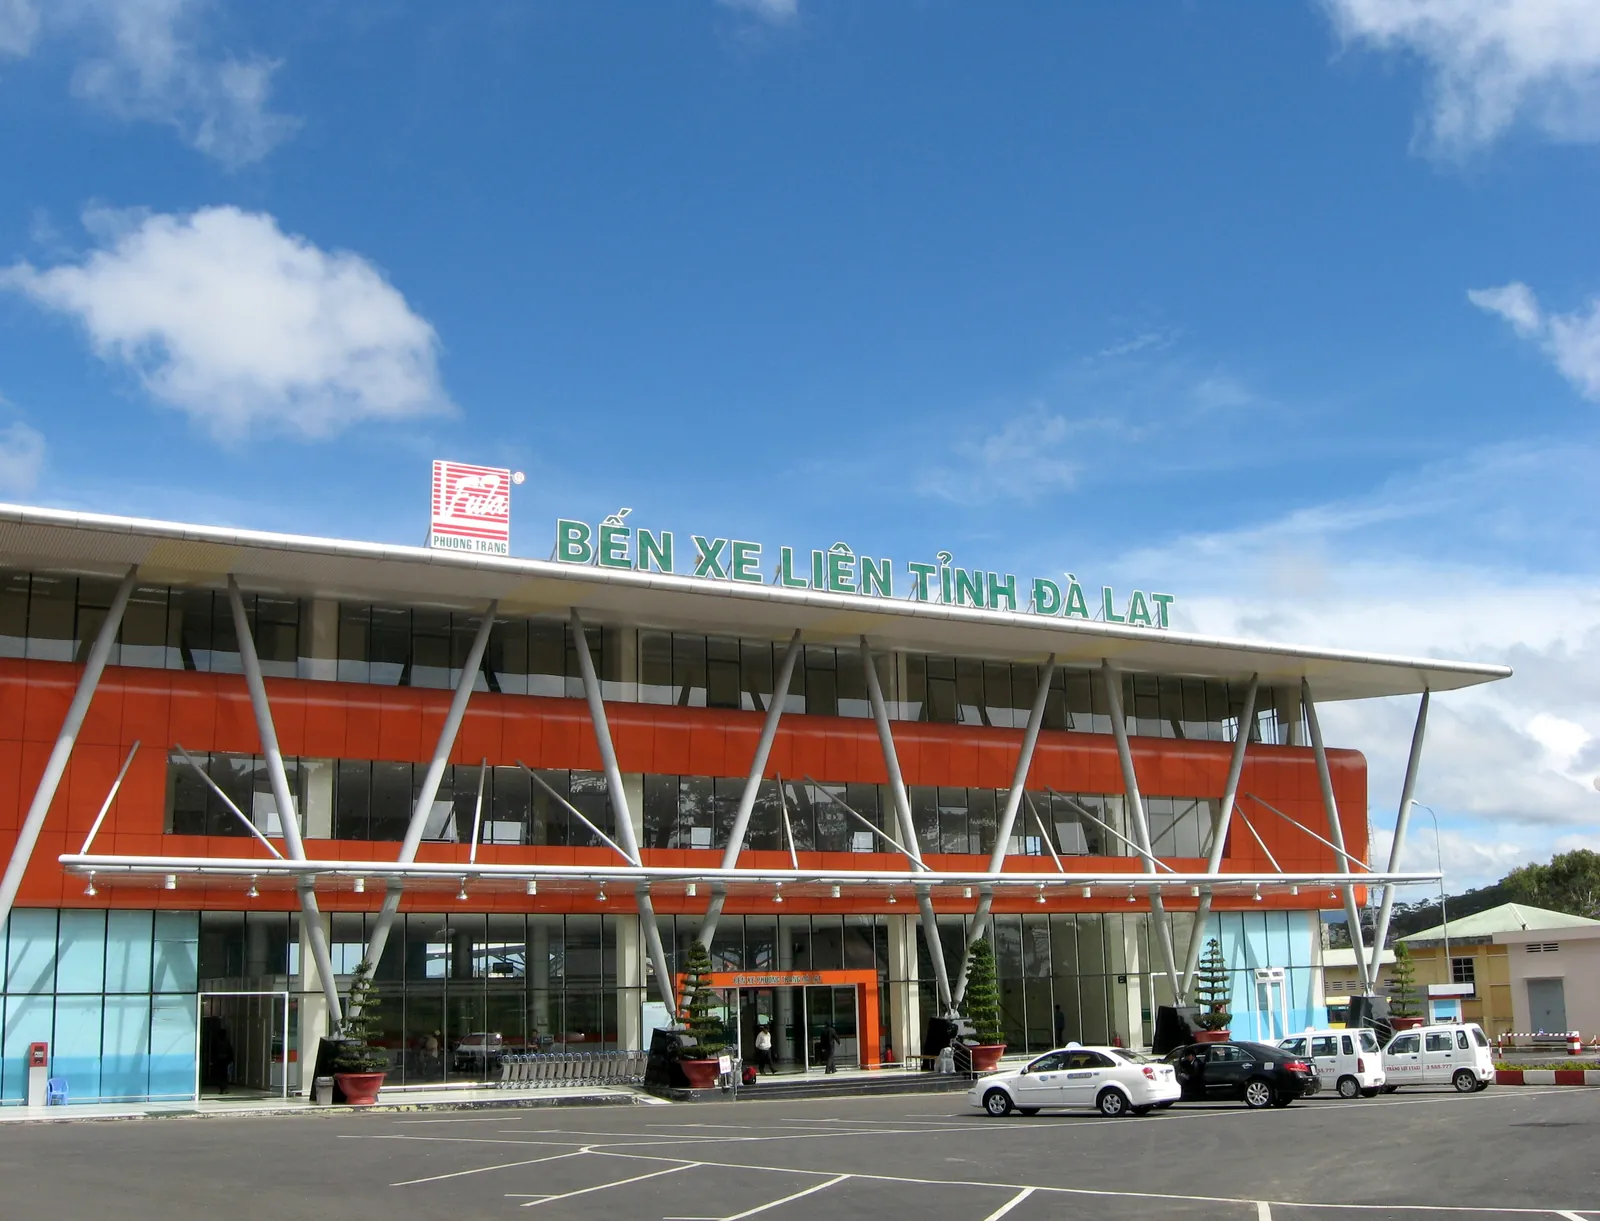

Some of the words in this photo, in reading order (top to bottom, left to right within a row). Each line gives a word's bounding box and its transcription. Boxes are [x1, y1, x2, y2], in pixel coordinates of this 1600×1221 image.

[475, 540, 507, 554] TRANG
[556, 507, 674, 574] BẾN
[691, 534, 764, 584] XE
[780, 541, 893, 598] LIÊN
[907, 551, 1017, 611] TỈNH
[1032, 573, 1090, 620] ĐÀ
[1101, 585, 1175, 629] LẠT
